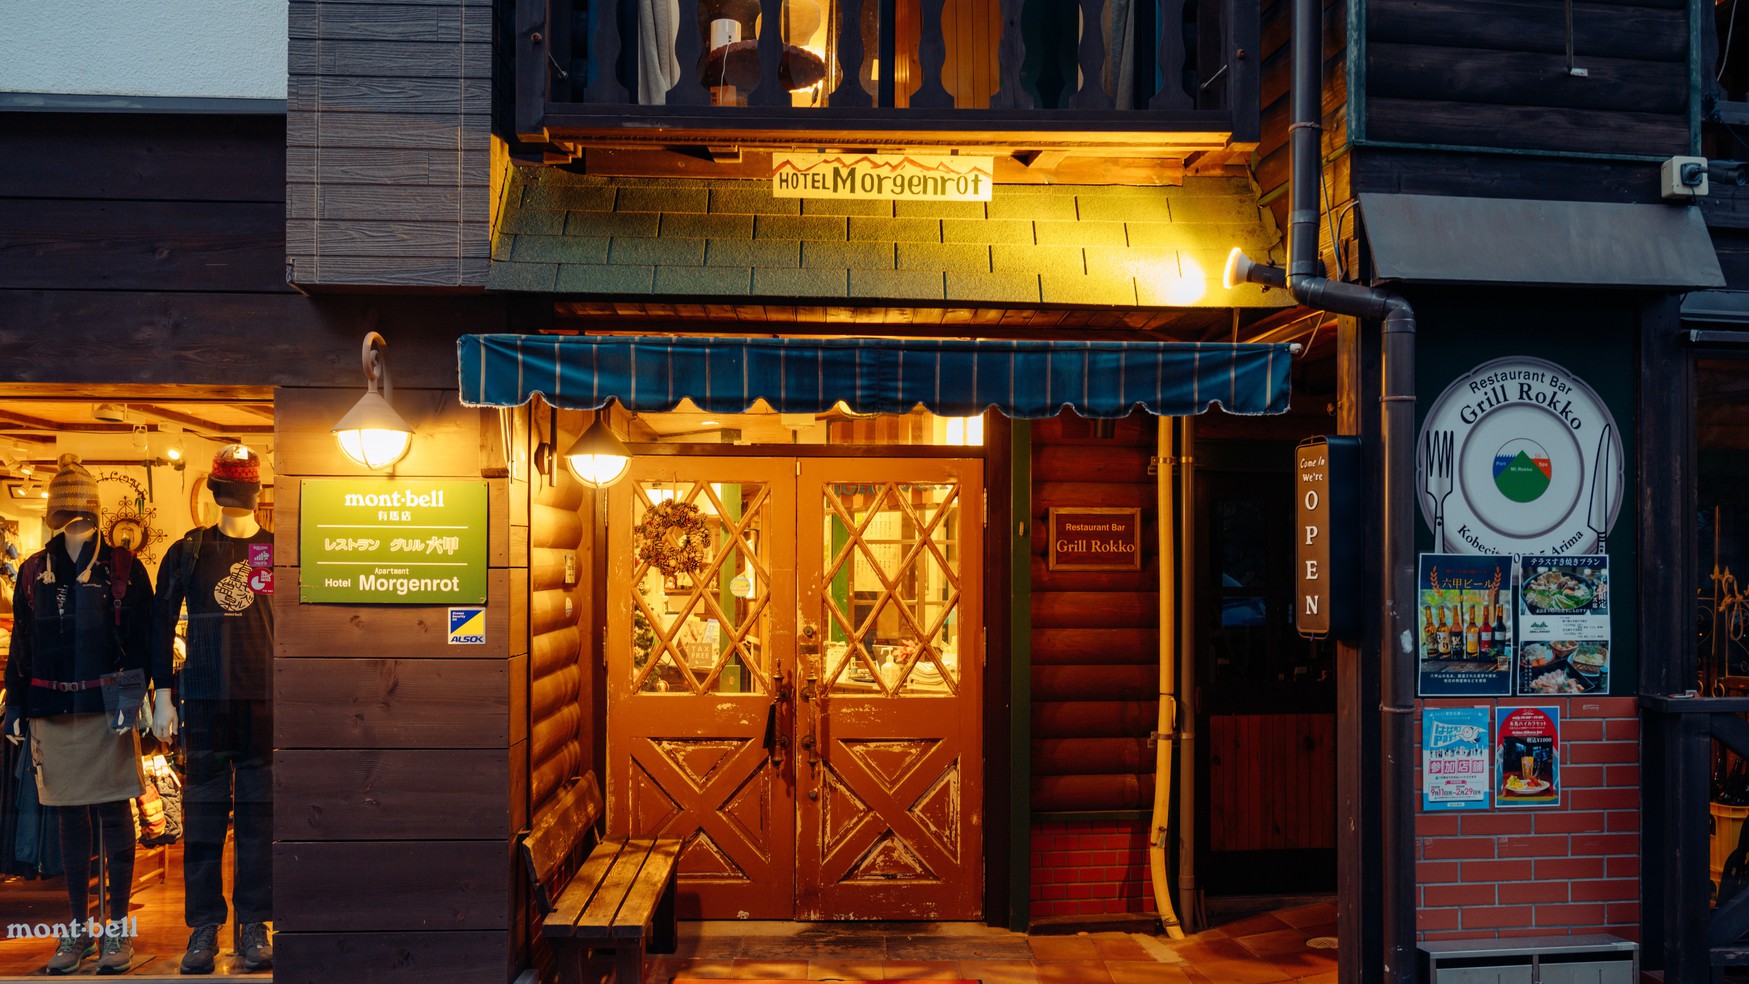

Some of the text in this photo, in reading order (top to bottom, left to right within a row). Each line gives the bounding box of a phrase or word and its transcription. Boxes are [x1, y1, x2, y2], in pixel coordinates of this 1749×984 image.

[779, 166, 982, 196] HOTEL Morgenrot
[1469, 370, 1572, 396] Restaurant Bar
[1460, 382, 1582, 430] Grill Rokko
[1300, 456, 1325, 468] Come In
[1302, 473, 1324, 482] We're
[93, 470, 148, 501] LCOME
[377, 511, 411, 521] 有馬店
[1065, 523, 1125, 531] Restaurant Bar
[325, 538, 380, 551] レストラン
[1056, 540, 1135, 552] Grill Rokko
[1551, 530, 1584, 555] Arima
[1305, 490, 1319, 615] OPEN
[325, 575, 460, 595] Hotel Morgenrot
[1442, 578, 1494, 589] 六甲ビール
[1429, 760, 1484, 774] 参加店舗
